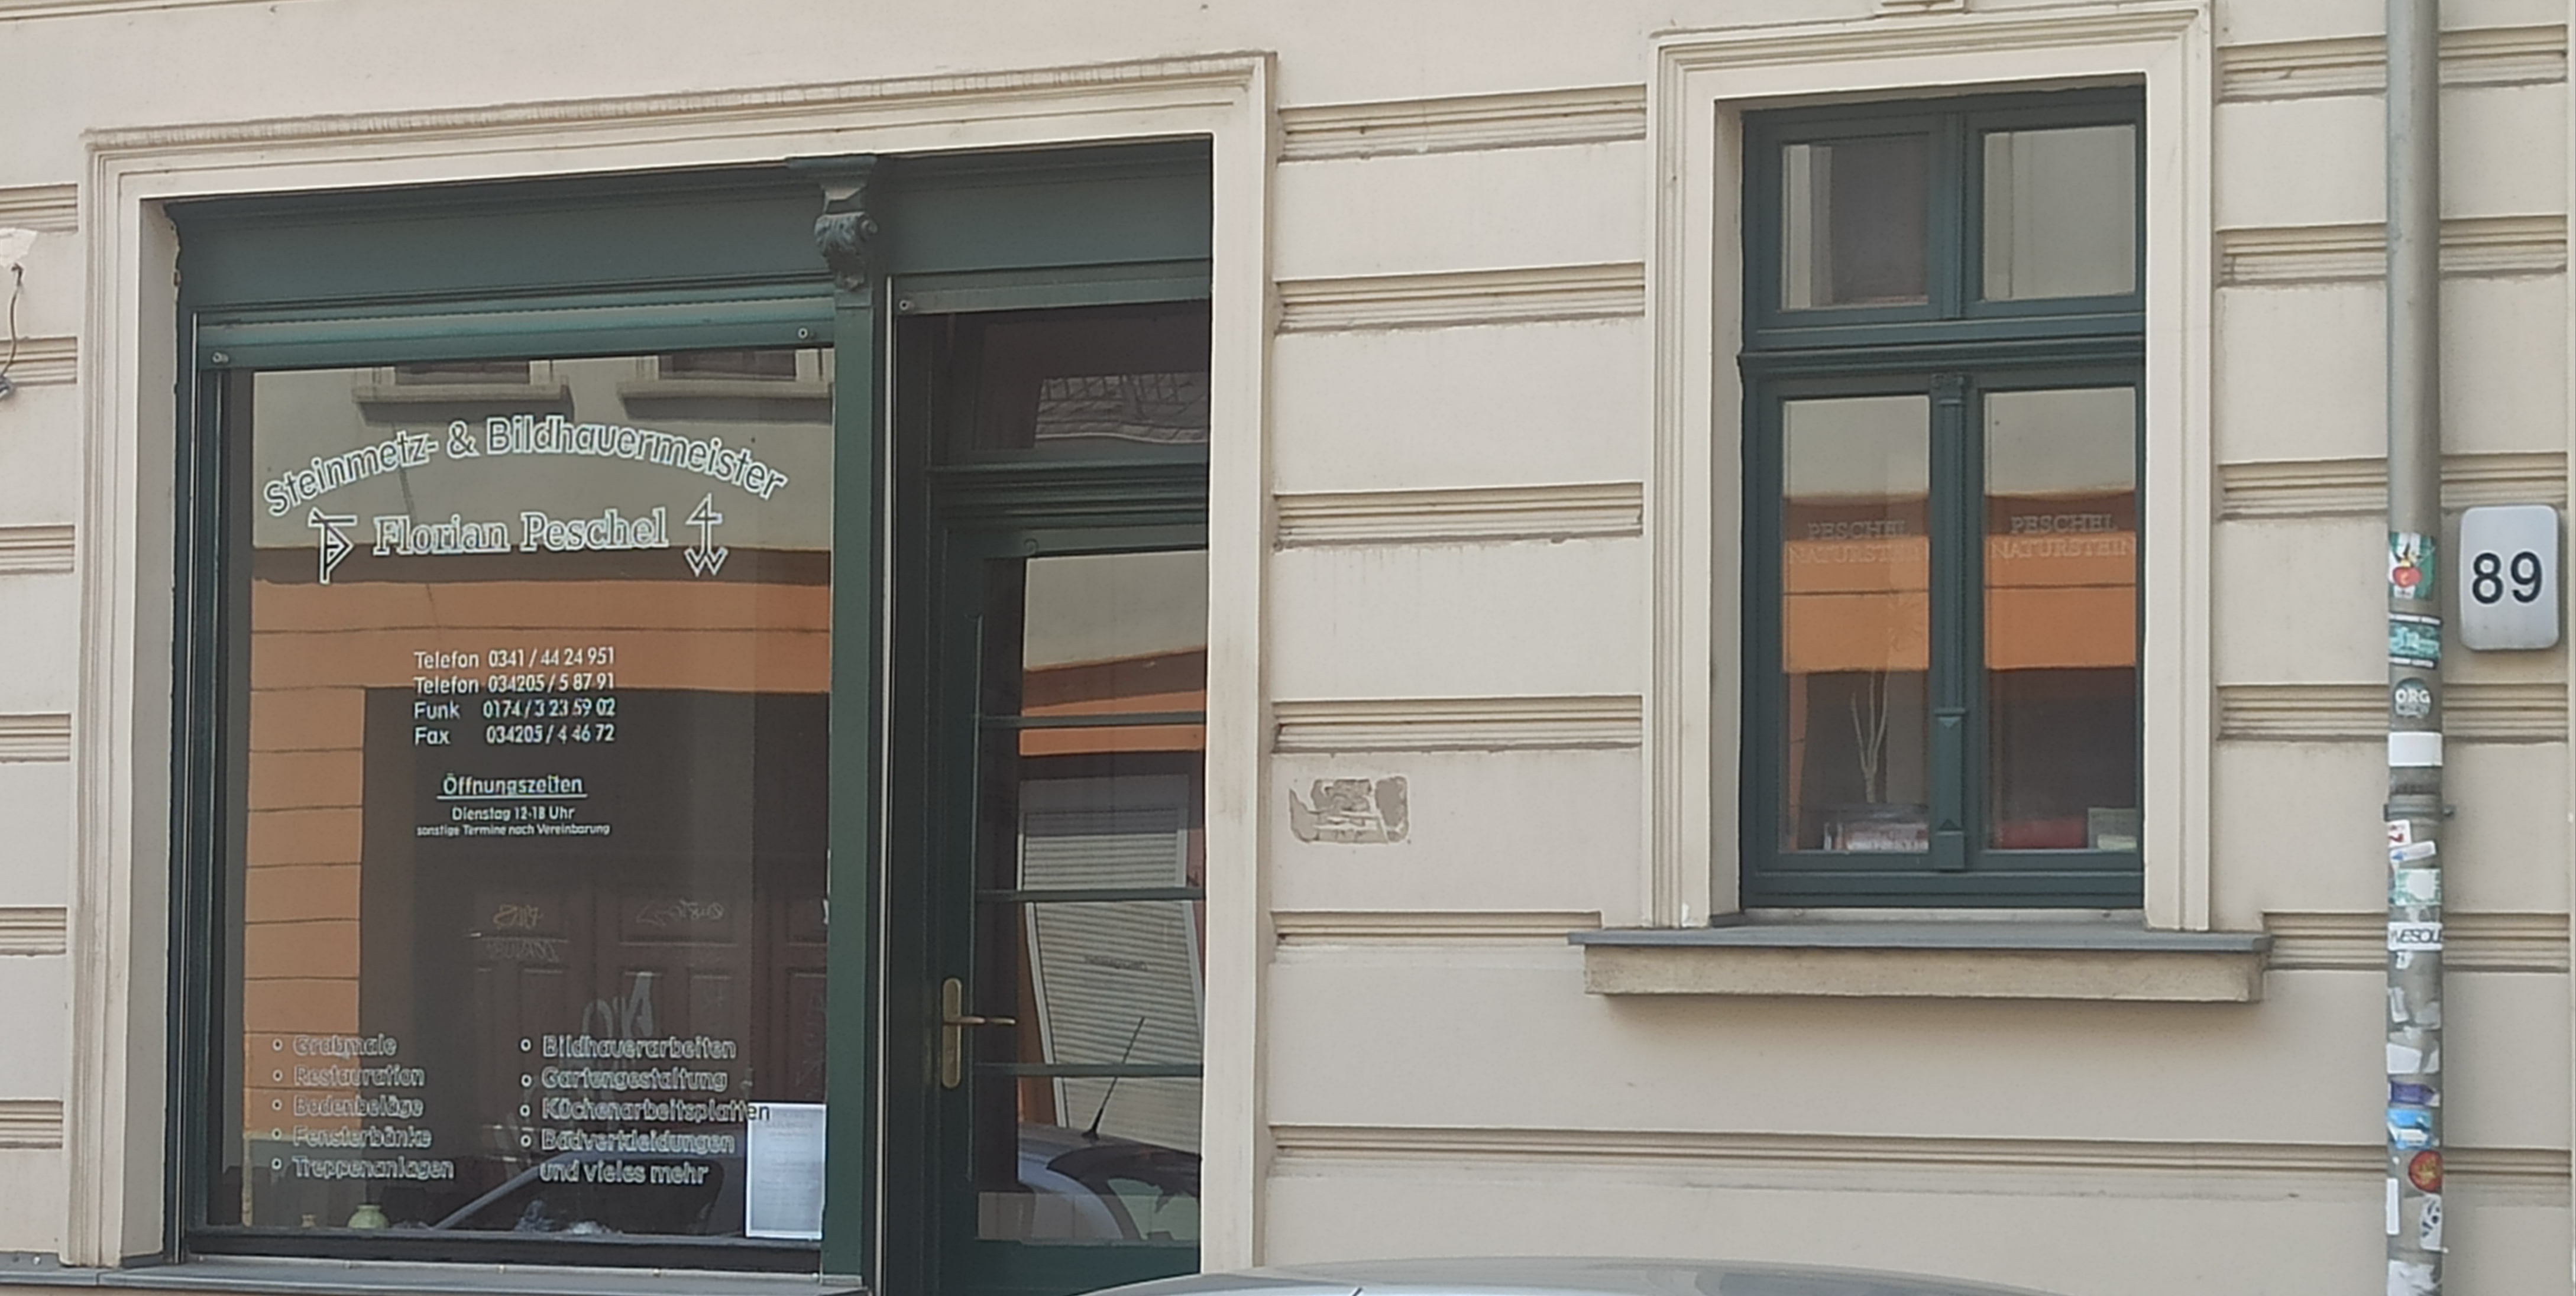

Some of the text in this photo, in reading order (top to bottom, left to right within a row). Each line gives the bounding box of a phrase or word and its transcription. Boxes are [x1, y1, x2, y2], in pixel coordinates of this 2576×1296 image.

[263, 415, 788, 517] Steinmetz- & Bildhauermeister
[373, 506, 669, 556] Florian Peschel
[1808, 520, 1907, 540] PESCHEL
[2011, 514, 2118, 534] PESCHEL
[2472, 551, 2543, 604] 89
[414, 651, 479, 669] Telefon
[488, 649, 524, 668] 0341
[540, 649, 559, 665] 44
[564, 648, 583, 666] 24
[588, 647, 614, 665] 951
[414, 676, 479, 694] Telefon
[488, 674, 545, 693] 034205
[559, 673, 568, 691] 5
[573, 673, 591, 691] 87
[597, 672, 614, 689] 91
[413, 700, 460, 720] Funk
[483, 699, 521, 718] 0174
[534, 699, 545, 717] 3
[549, 699, 568, 717] 23
[574, 698, 591, 717] 59
[596, 698, 616, 717] 02
[415, 725, 450, 745] Fax
[486, 725, 543, 744] 034205
[558, 724, 567, 744] 4
[572, 724, 591, 742] 46
[596, 724, 616, 741] 72
[443, 773, 582, 796] Öffnungszeiten
[452, 805, 575, 821] Dienstag 12-18 Uhr
[417, 823, 610, 836] sonstige Termine nach Vereinbarung
[293, 1034, 397, 1057] Grabmale
[542, 1035, 737, 1060] Bildhauerarbeiten
[294, 1064, 425, 1086] Restauration
[542, 1067, 728, 1091] Gartengestaltung
[293, 1094, 423, 1119] Bodenbeläge
[542, 1098, 771, 1123] Küchenarbeitsplatten
[293, 1125, 432, 1148] Fensterbänke
[541, 1129, 735, 1155] Badverkleidungen
[292, 1156, 454, 1180] Treppenanlagen
[539, 1160, 708, 1184] und vieles mehr
